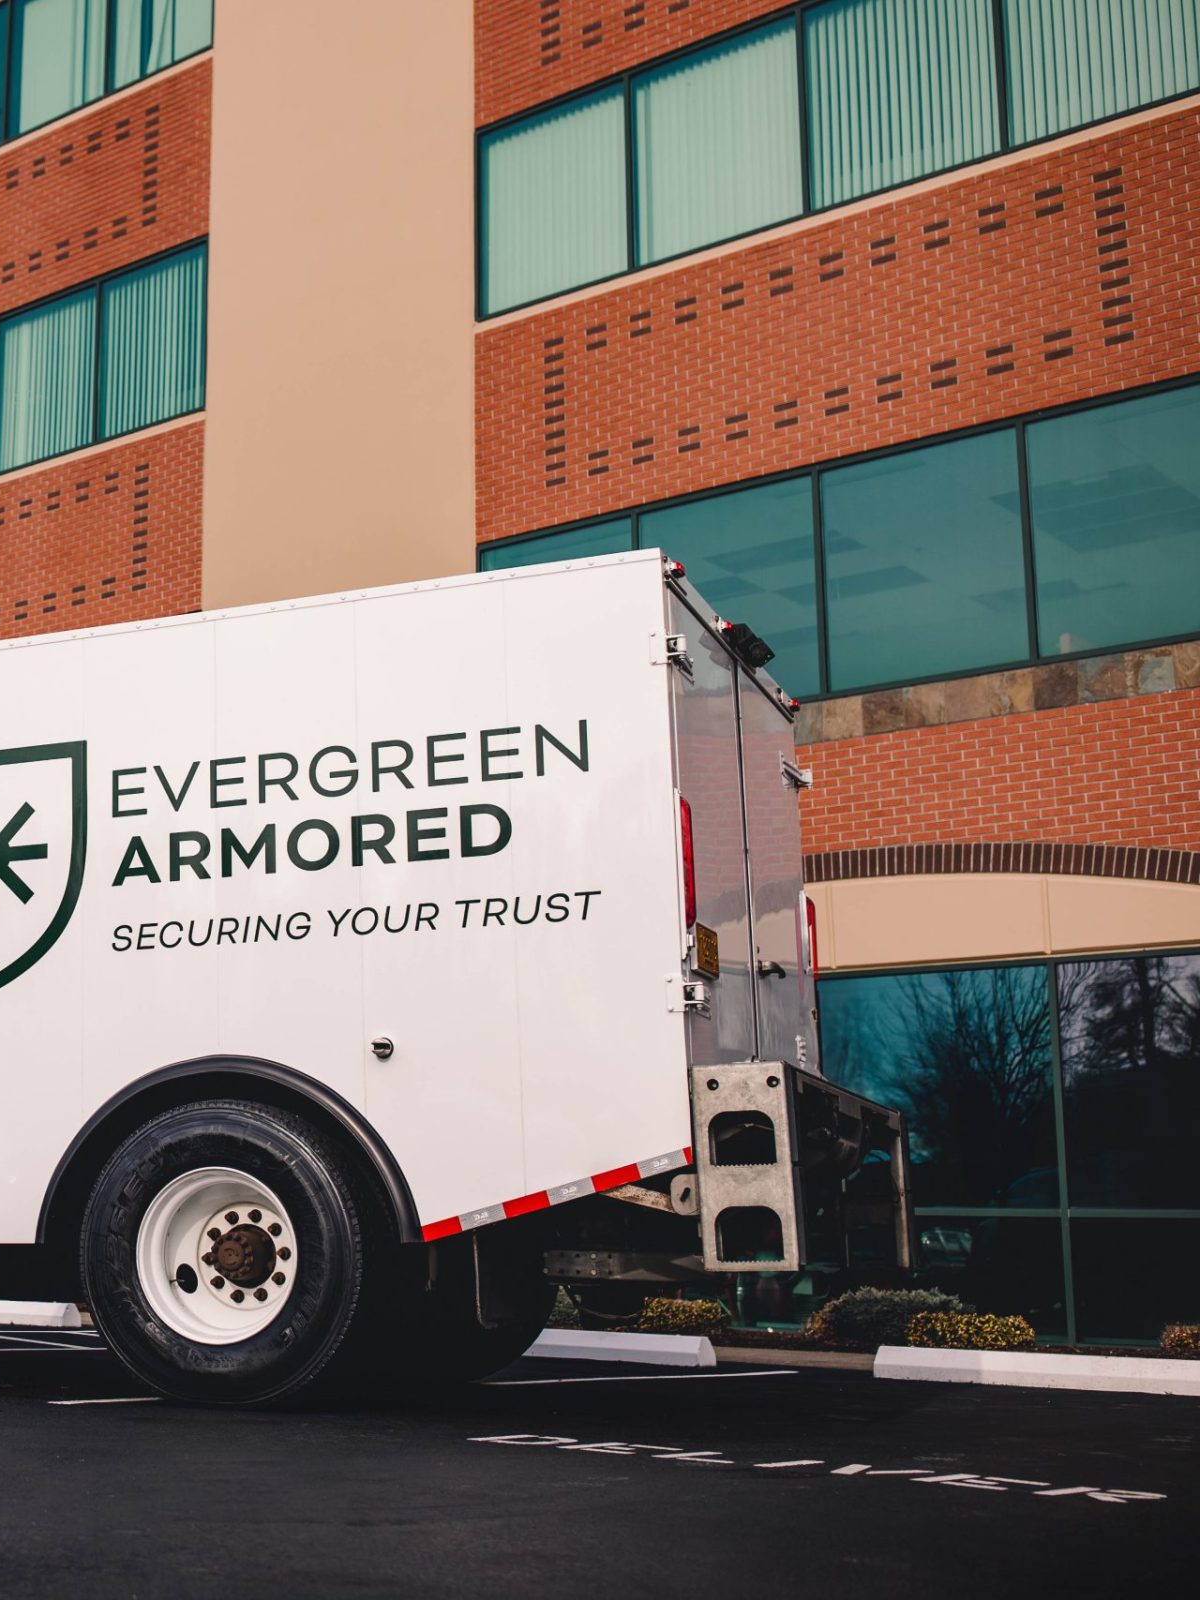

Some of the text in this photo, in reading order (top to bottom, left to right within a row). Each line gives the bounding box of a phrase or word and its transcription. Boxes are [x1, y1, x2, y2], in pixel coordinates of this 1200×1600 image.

[112, 719, 589, 817] EVERGREEN
[112, 803, 512, 886] ARMORED
[111, 890, 601, 951] SECURING YOUR TRUST
